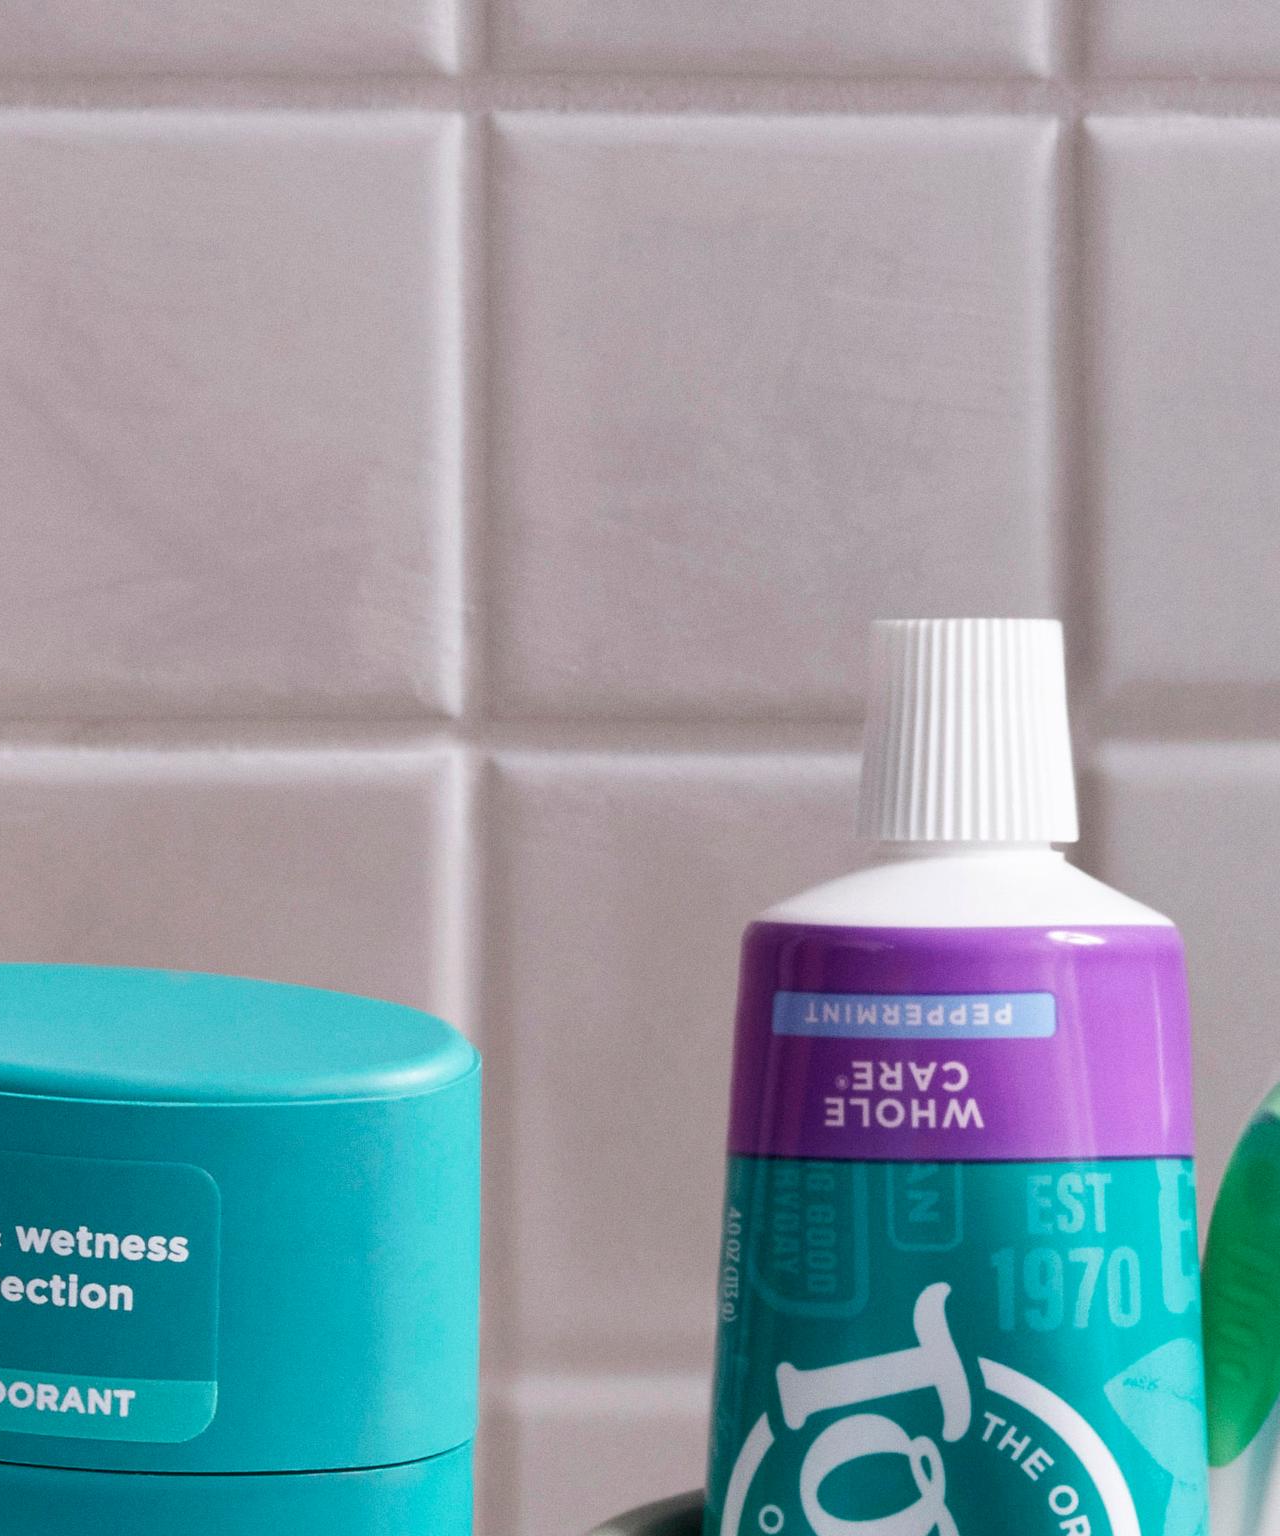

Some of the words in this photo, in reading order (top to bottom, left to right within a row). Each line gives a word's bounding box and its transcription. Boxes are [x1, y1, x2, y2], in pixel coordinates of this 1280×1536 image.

[804, 1002, 1013, 1027] PEPPERMINT
[824, 1097, 985, 1129] WHOLE
[1027, 1172, 1112, 1236] EST
[15, 1223, 190, 1264] wetness
[991, 1246, 1141, 1332] 1970
[982, 1410, 1055, 1481] THE
